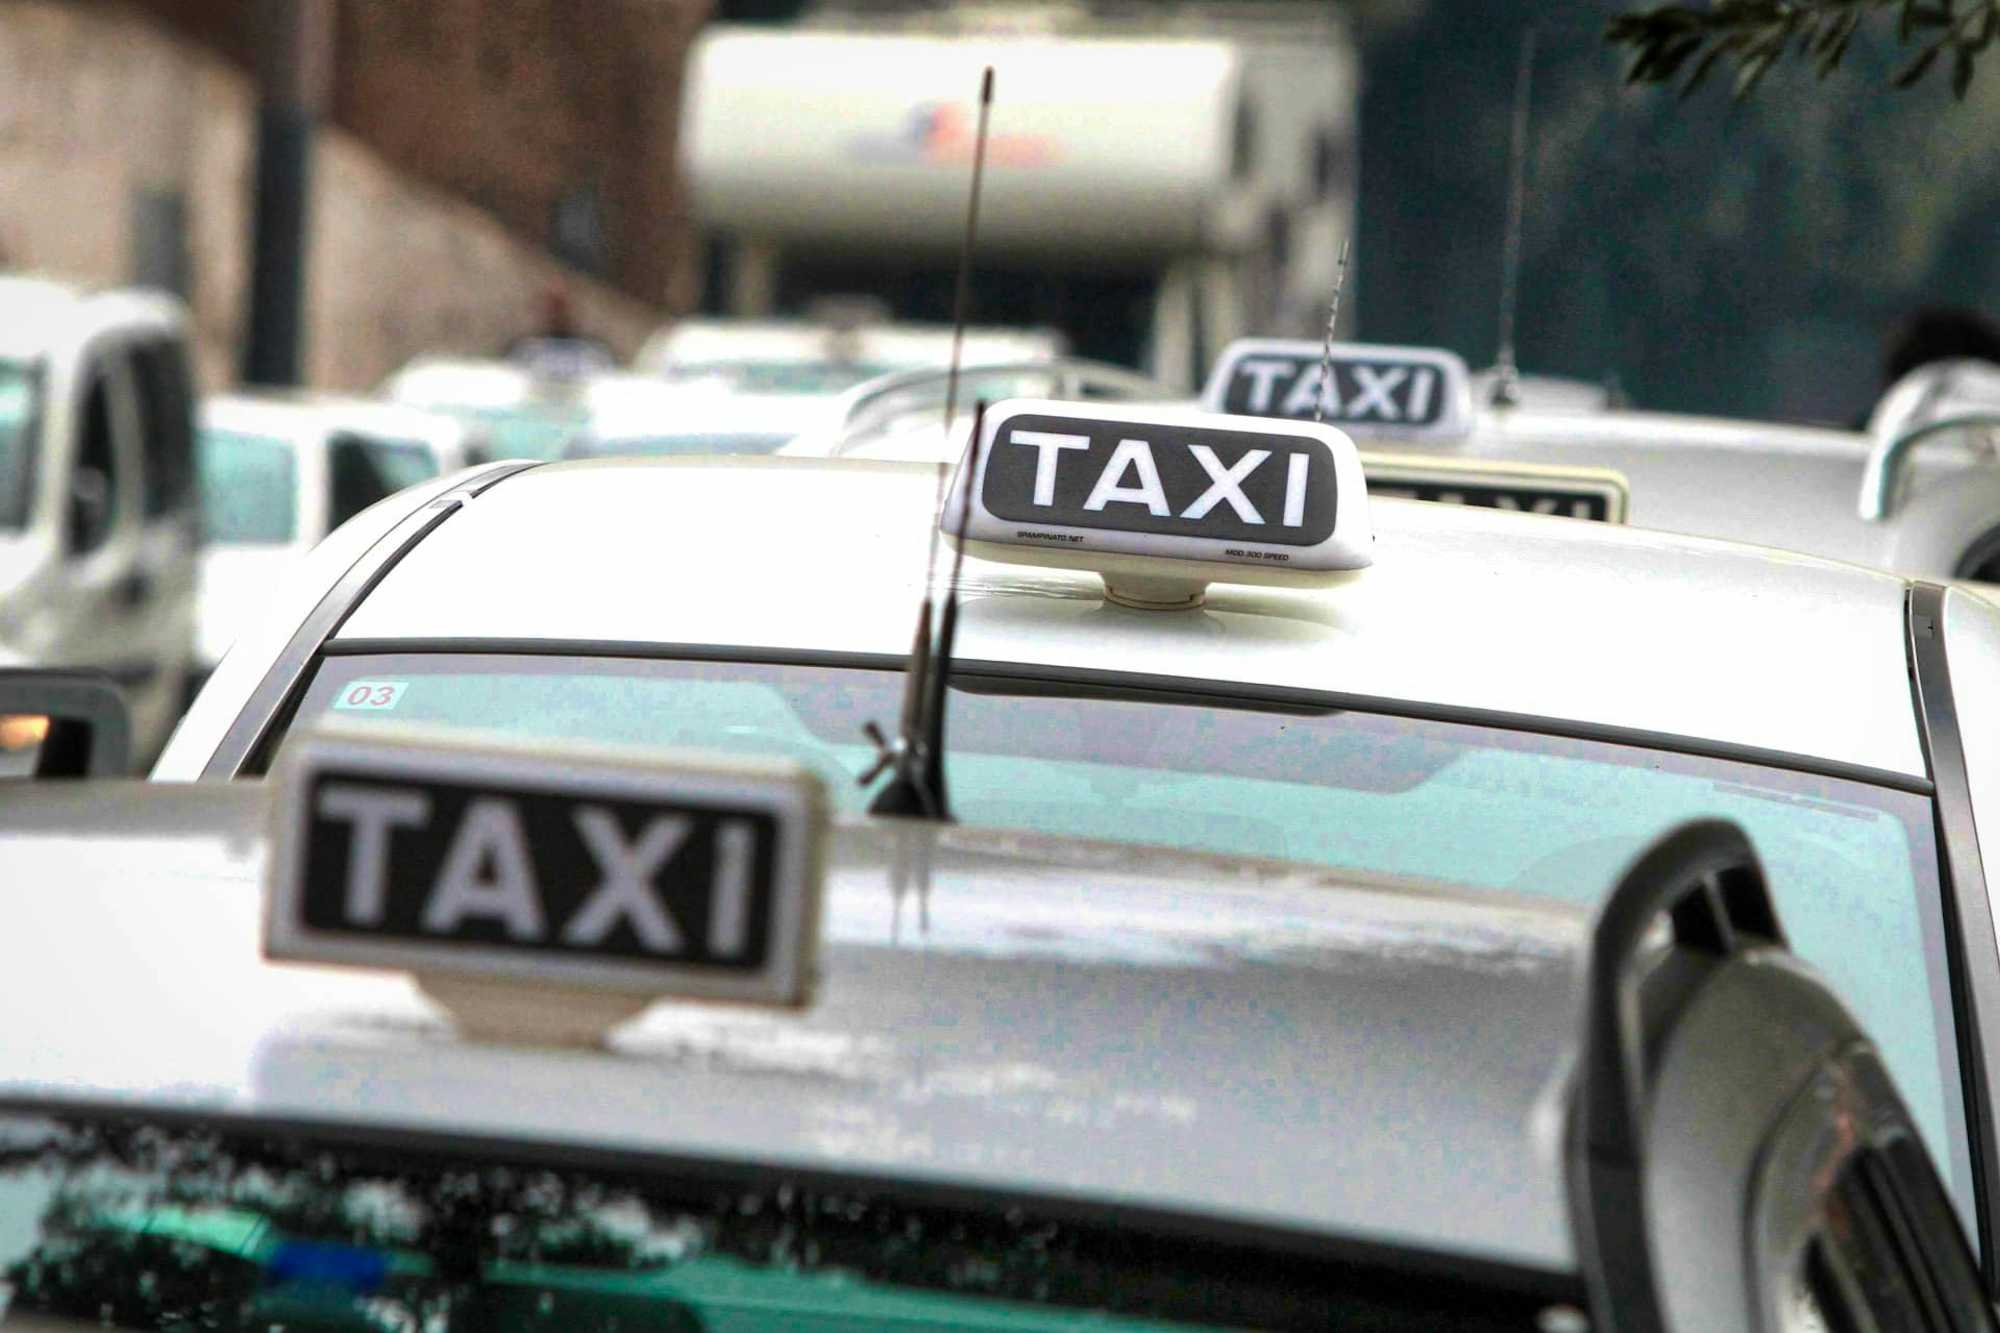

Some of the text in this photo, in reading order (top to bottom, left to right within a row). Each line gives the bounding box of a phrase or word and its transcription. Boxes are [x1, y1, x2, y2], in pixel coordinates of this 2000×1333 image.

[1239, 361, 1434, 419] TAXI
[1010, 430, 1310, 527] TAXI
[347, 686, 395, 706] 03
[316, 782, 757, 958] TAXI
